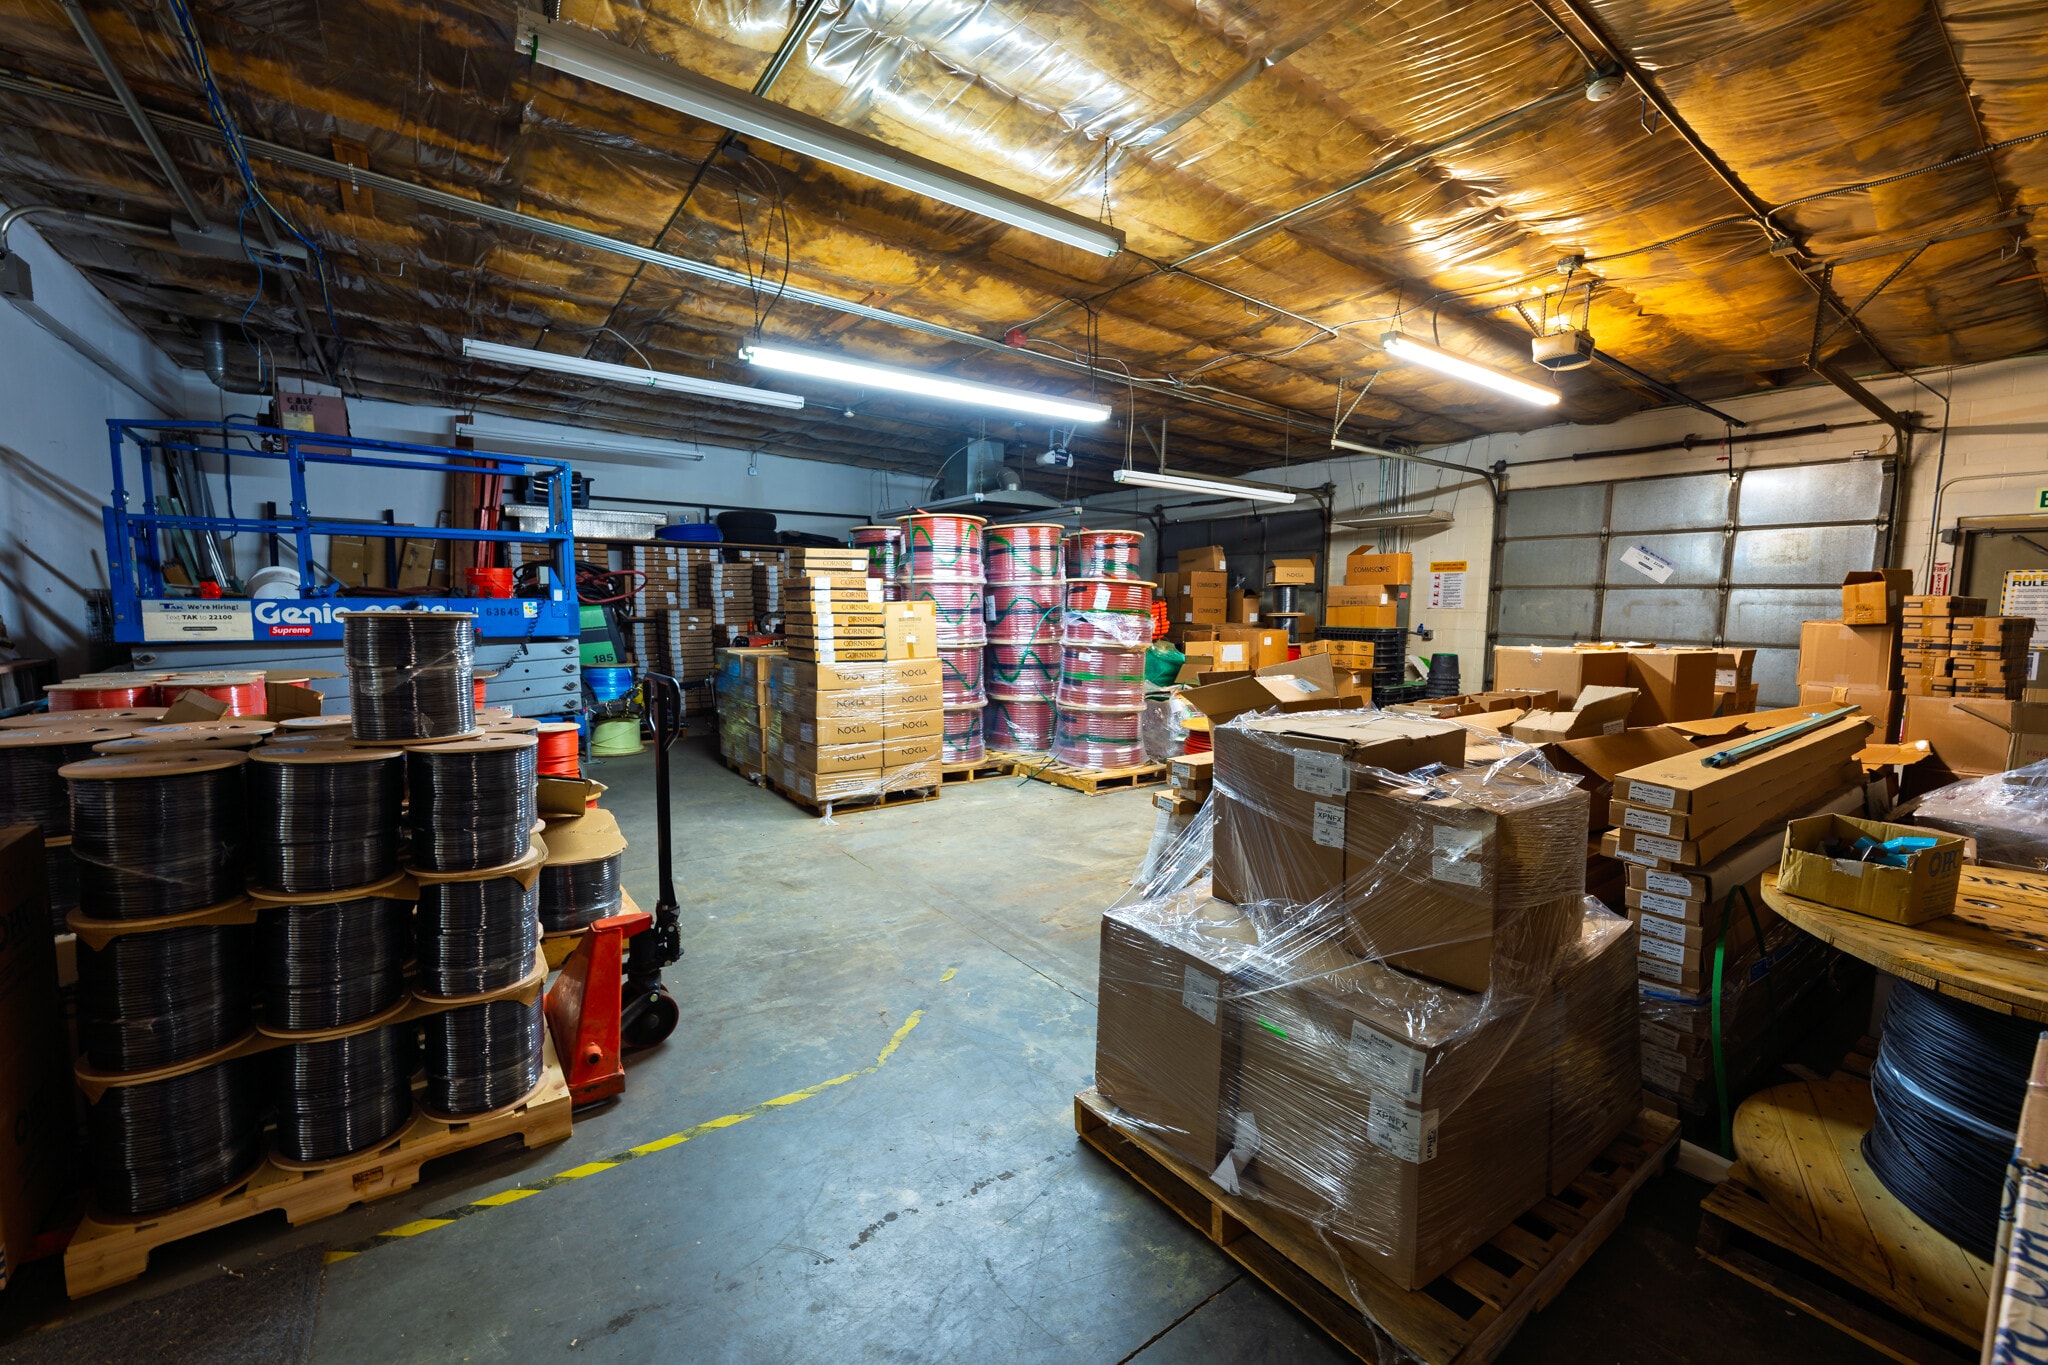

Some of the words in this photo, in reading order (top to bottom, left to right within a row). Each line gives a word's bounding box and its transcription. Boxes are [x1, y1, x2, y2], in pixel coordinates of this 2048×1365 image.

[1353, 565, 1391, 574] COMMSCOPE
[212, 603, 239, 611] Hiring!
[486, 607, 520, 616] 63645
[254, 602, 350, 624] Genie
[272, 626, 311, 636] Supreme
[593, 653, 614, 663] 185
[901, 669, 928, 677] NOKIA
[836, 699, 865, 708] NOKIA
[901, 695, 928, 703] NOKIA
[902, 720, 929, 729] NOKIA
[837, 726, 866, 735] NOKIA
[901, 746, 928, 755] NOKIA
[837, 753, 866, 762] NOKIA
[901, 771, 928, 781] NOKIA
[1317, 811, 1342, 823] XPNFX
[1376, 1108, 1409, 1131] XPNFX
